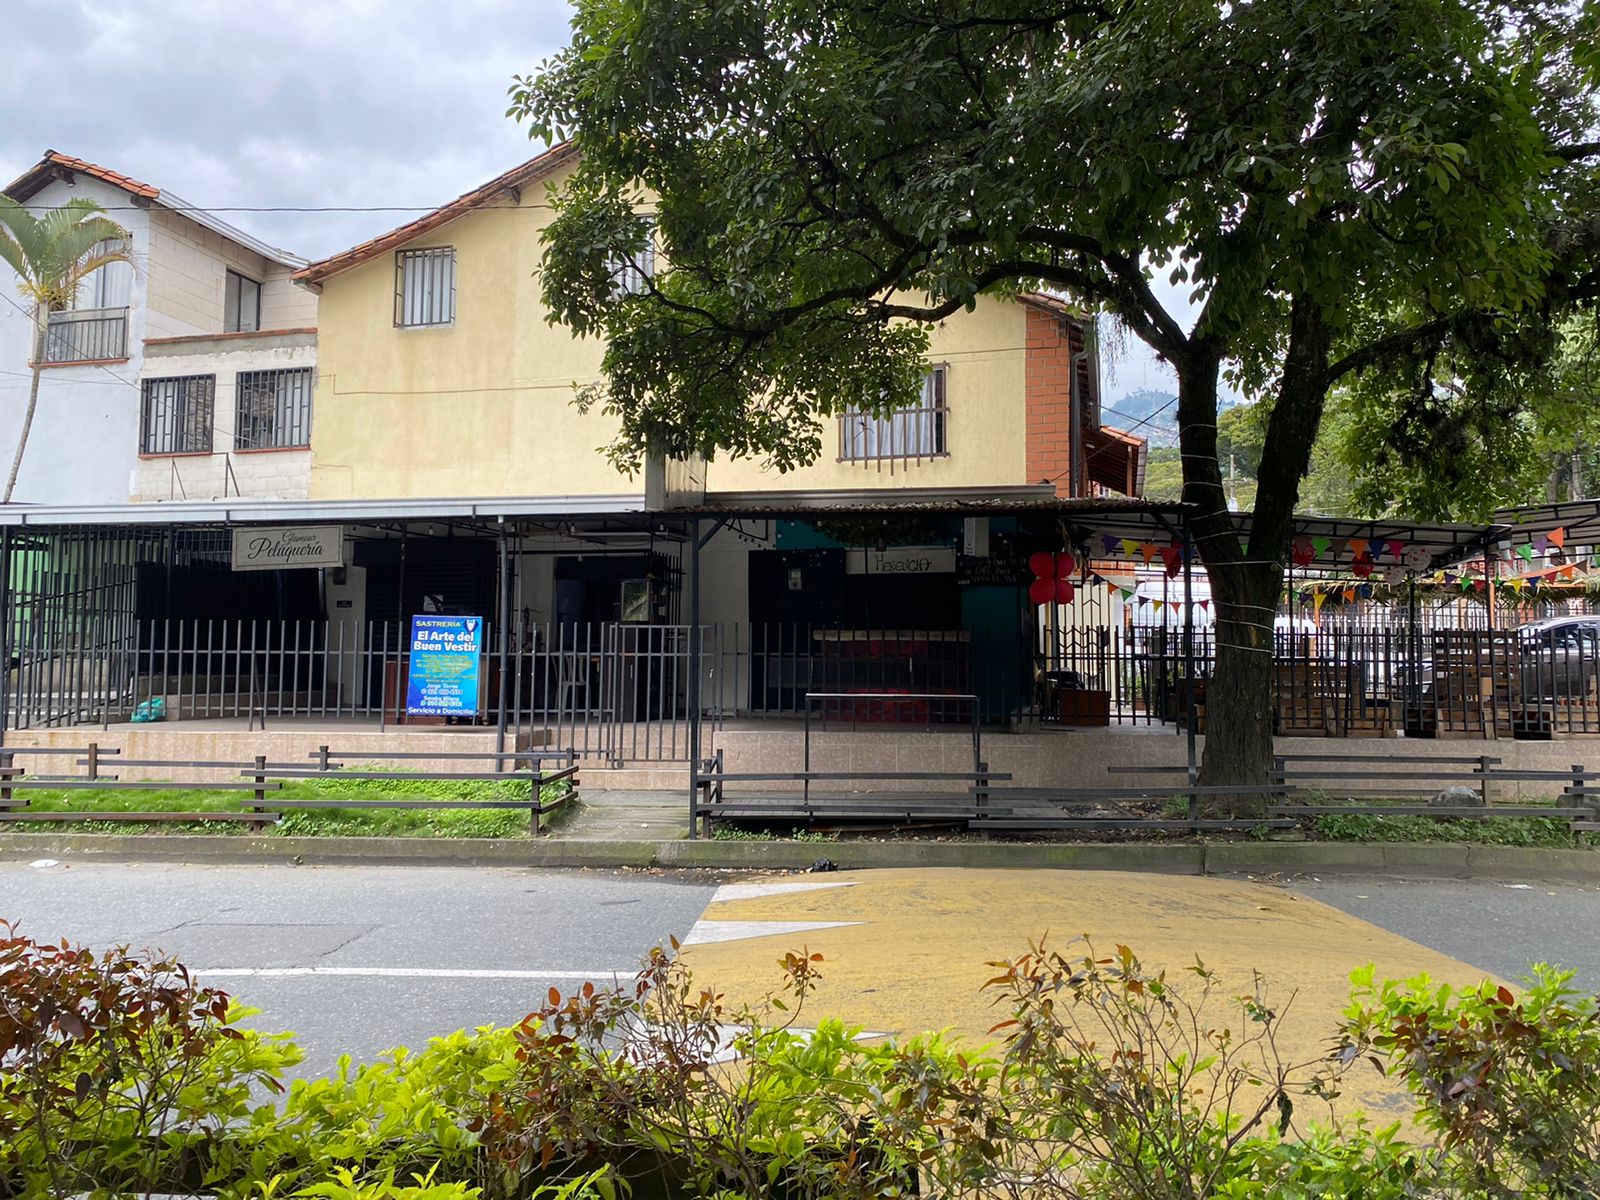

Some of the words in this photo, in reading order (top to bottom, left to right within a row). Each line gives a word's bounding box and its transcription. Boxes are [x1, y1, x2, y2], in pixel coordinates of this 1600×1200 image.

[282, 530, 317, 545] Glamour
[248, 537, 323, 563] Peluquería
[417, 631, 429, 641] El
[430, 631, 455, 641] Arte
[456, 632, 474, 642] del
[413, 641, 442, 651] Buen
[443, 642, 477, 652] Vestir
[442, 708, 474, 716] Domicilio
